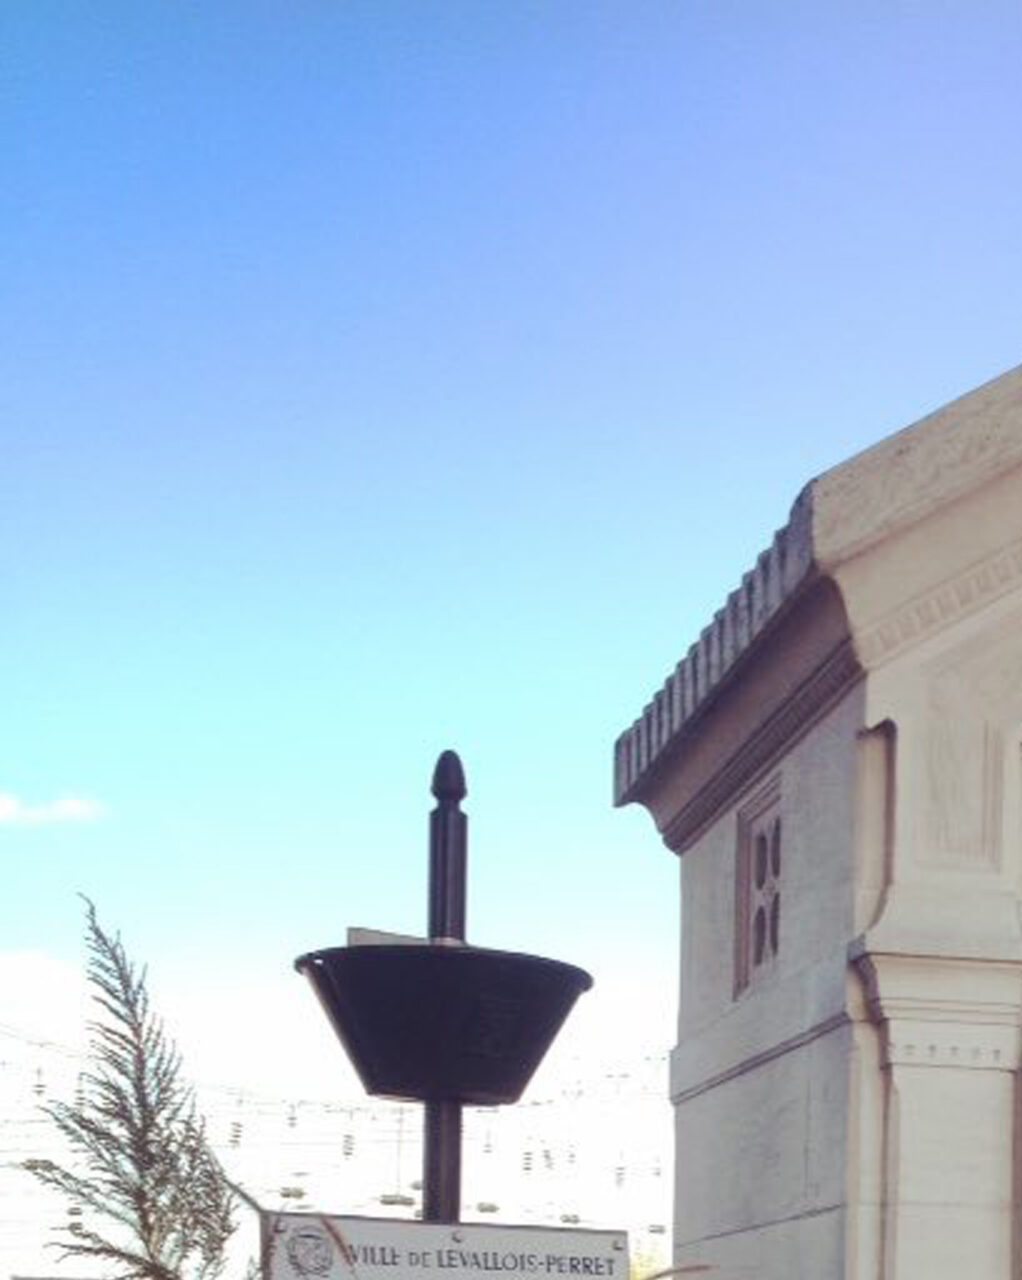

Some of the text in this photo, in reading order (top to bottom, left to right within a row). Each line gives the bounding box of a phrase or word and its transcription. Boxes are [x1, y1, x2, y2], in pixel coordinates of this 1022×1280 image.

[349, 1244, 616, 1276] VILLE DE LEVALLOIS-PERRET
